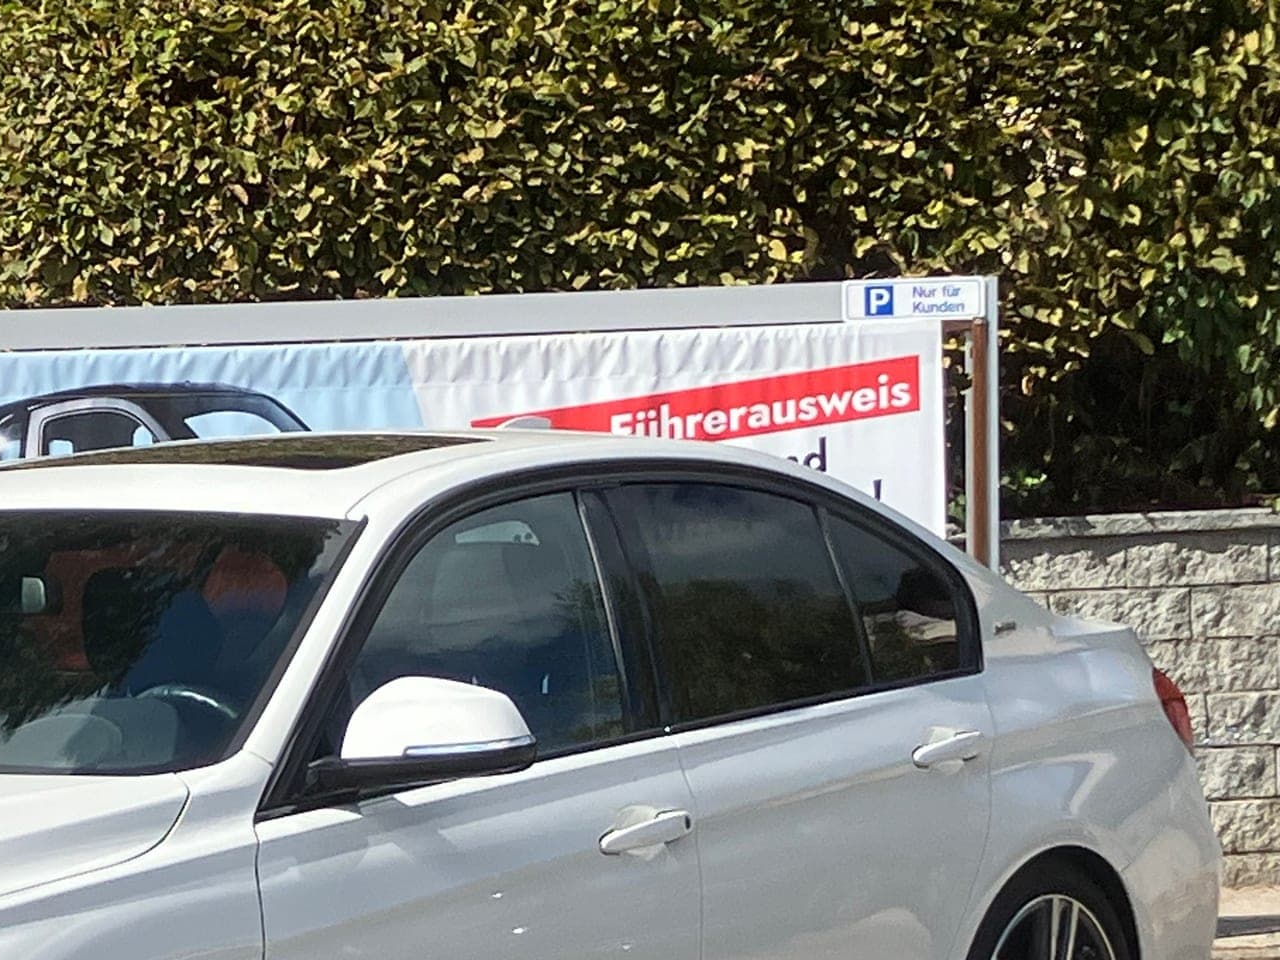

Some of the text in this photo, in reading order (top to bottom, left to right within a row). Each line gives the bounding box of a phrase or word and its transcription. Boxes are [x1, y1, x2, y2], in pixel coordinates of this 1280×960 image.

[869, 288, 890, 315] P
[912, 285, 961, 298] Nur für
[912, 301, 965, 314] Kunden
[610, 374, 911, 440] Führerausweis
